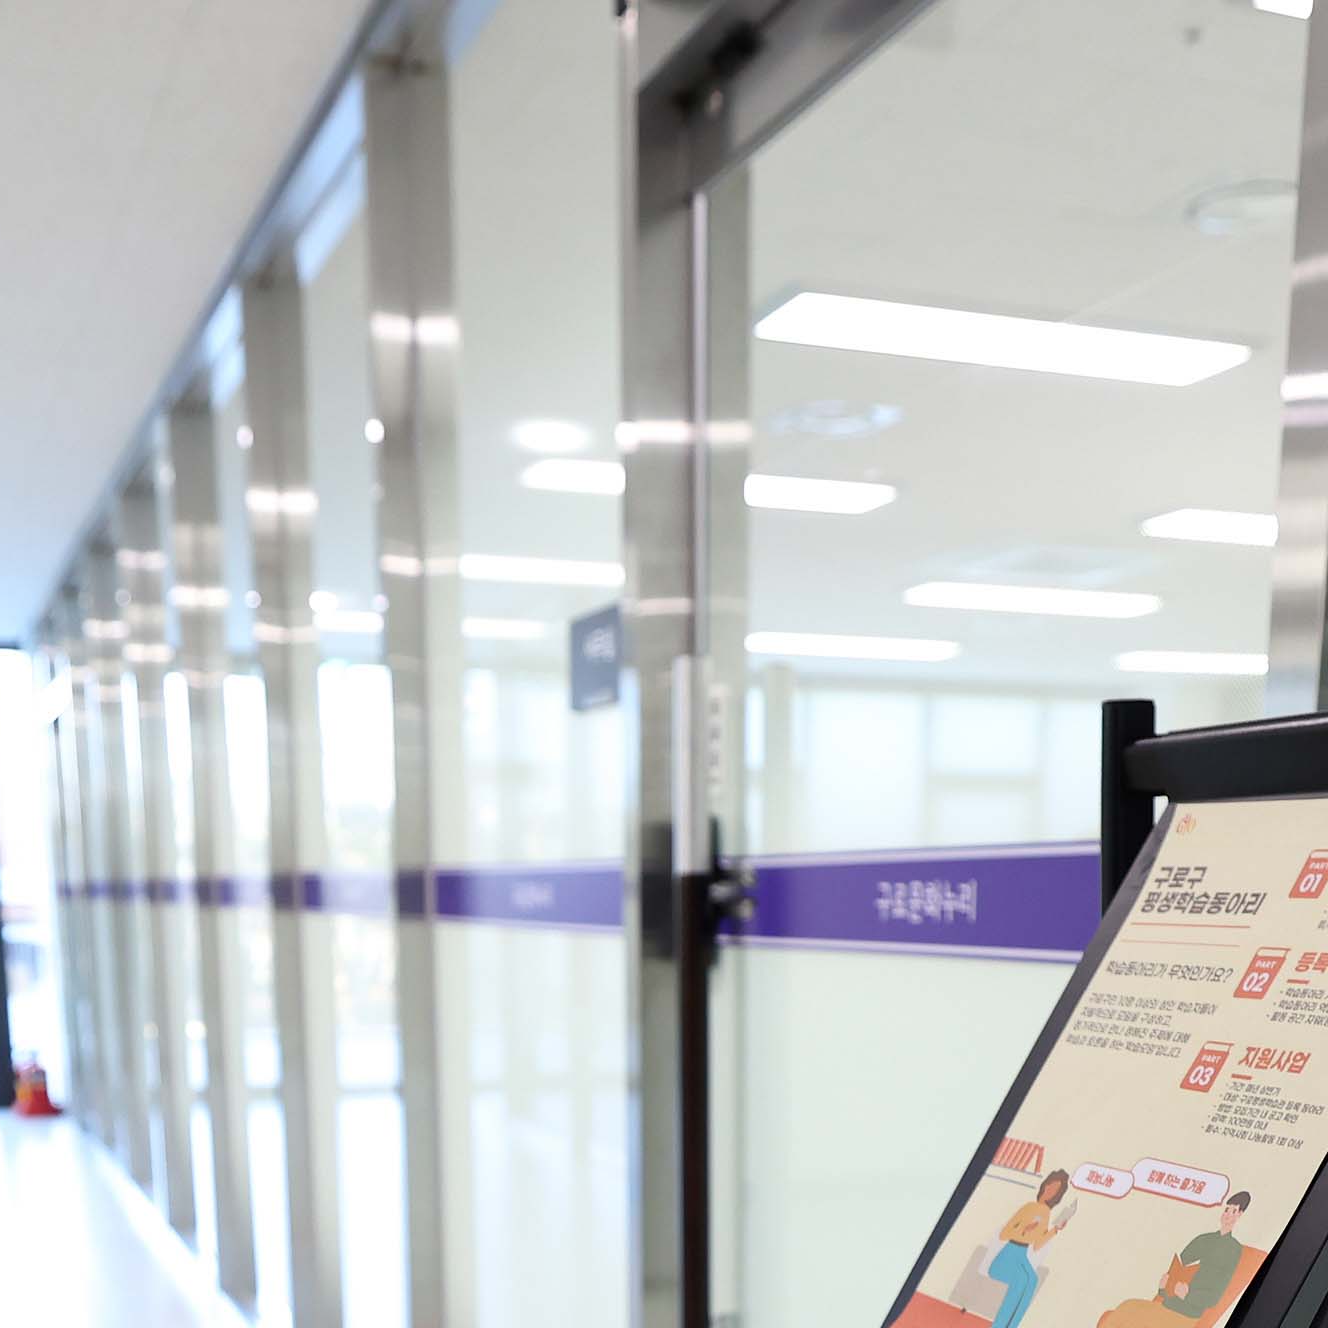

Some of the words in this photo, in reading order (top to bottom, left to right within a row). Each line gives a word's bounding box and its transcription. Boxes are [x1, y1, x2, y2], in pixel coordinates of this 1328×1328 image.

[1154, 867, 1207, 889] 구로구
[1299, 874, 1323, 893] 01
[1141, 892, 1267, 915] 평생학습동아리
[1107, 961, 1168, 978] 학습동아리가
[1170, 964, 1233, 983] 무엇인가요?
[1243, 972, 1270, 991] 02
[1238, 1047, 1312, 1074] 지원사업
[1189, 1066, 1215, 1086] 03
